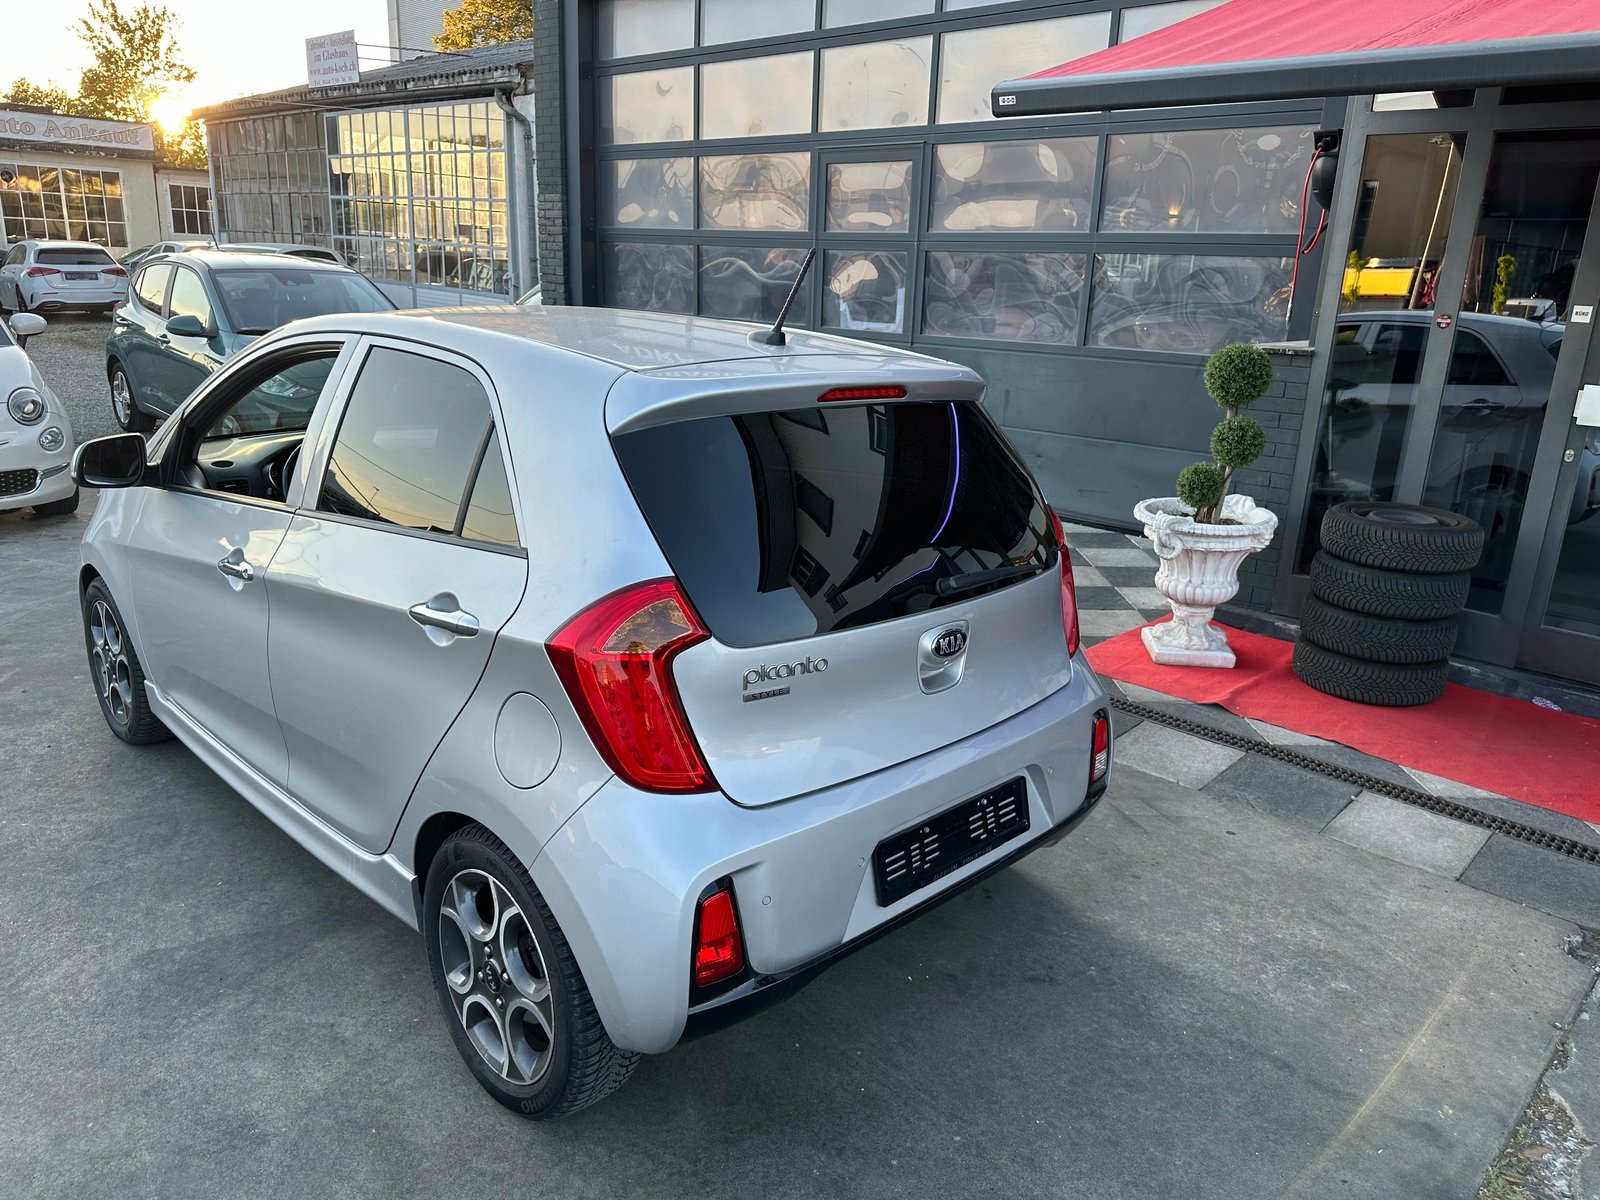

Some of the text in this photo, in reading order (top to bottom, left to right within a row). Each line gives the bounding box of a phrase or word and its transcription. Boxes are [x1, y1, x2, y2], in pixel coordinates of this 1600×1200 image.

[314, 48, 348, 62] im Glashaus
[309, 61, 356, 75] www.auto-koch.ch
[43, 119, 139, 145] Ankauf
[939, 633, 964, 655] KIA
[743, 656, 828, 690] picanto
[751, 687, 785, 701] STYLE
